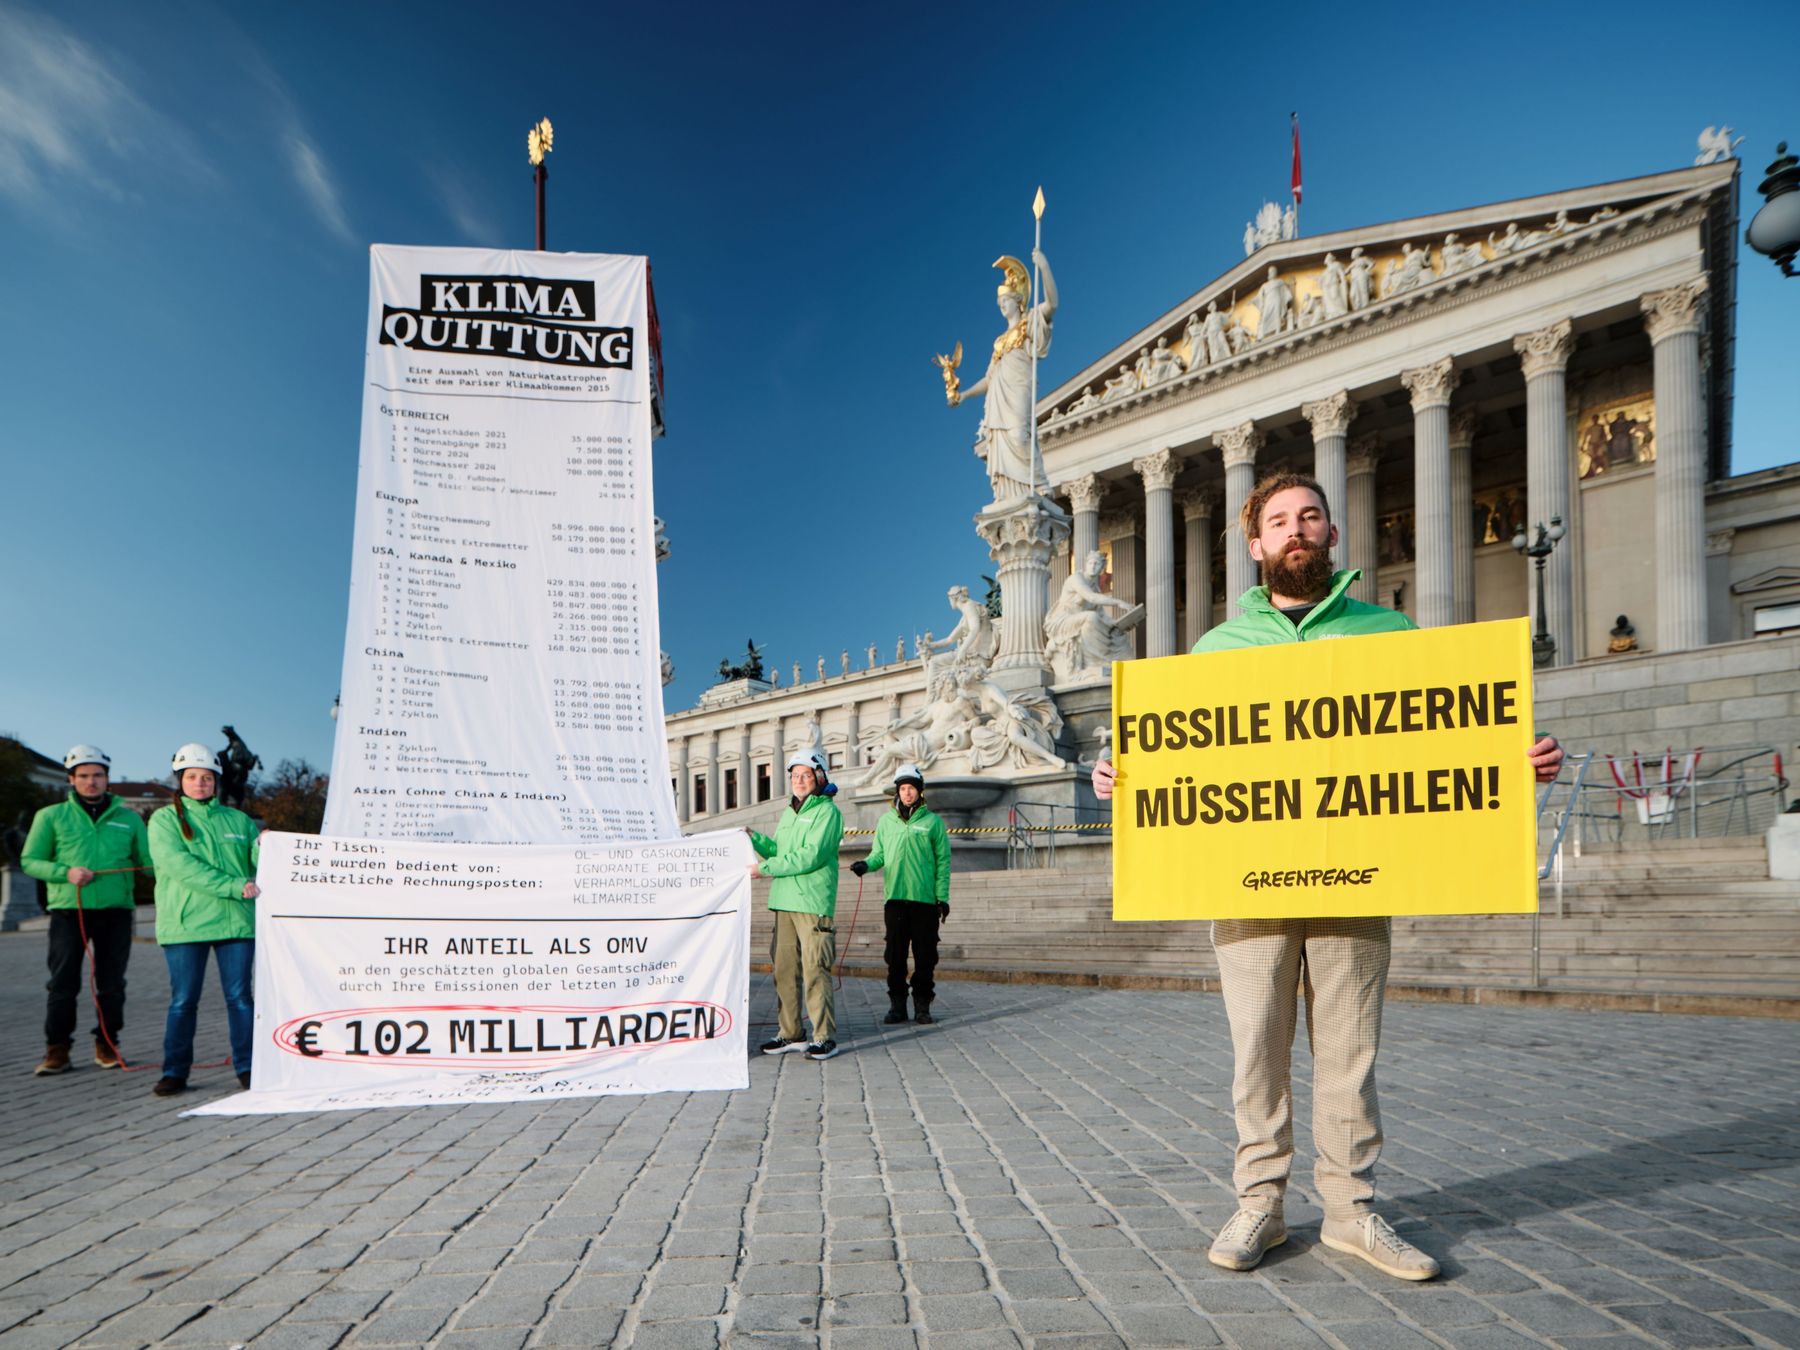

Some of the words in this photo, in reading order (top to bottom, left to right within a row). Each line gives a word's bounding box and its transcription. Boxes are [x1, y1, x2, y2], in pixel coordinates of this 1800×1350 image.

[432, 281, 585, 318] KLIMA
[384, 312, 630, 363] QUITTUNG
[409, 367, 432, 375] Eine
[439, 368, 479, 376] Auswahl
[509, 370, 606, 382] Naturkatastrophen
[436, 377, 453, 385] dem
[460, 379, 501, 387] Pariser
[507, 382, 582, 392] Klimaabkommen
[380, 403, 449, 421] ÖSTERREICH
[414, 426, 480, 436] Hagelschäden
[414, 437, 479, 448] Murenabgänge
[414, 447, 441, 456] Dürre
[413, 458, 469, 469] Hochwasser
[376, 491, 419, 506] Europa
[411, 511, 490, 527] Überschwemmung
[411, 523, 440, 532] Sturm
[410, 533, 456, 545] Weiteres
[462, 539, 529, 551] Extremwetter
[410, 552, 453, 564] Kanada
[475, 559, 516, 569] Mexiko
[409, 568, 456, 578] Hurrikan
[408, 578, 461, 590] Waldbrand
[408, 588, 437, 597] Dürre
[408, 599, 448, 610] Tornado
[407, 610, 436, 620] Hagel
[406, 621, 442, 631] Zyklon
[405, 631, 453, 643] Weiteres
[460, 638, 530, 650] Extremwetter
[365, 648, 404, 658] China
[403, 665, 488, 682] Überschwemmung
[404, 677, 440, 687] Taifun
[402, 688, 433, 697] Dürre
[402, 699, 433, 708] Sturm
[401, 710, 438, 719] Zyklon
[1120, 702, 1271, 755] FOSSILE
[1285, 680, 1518, 741] KONZERNE
[359, 727, 407, 737] Indien
[398, 744, 437, 753] Zyklon
[397, 754, 487, 767] Überschwemmung
[396, 766, 448, 775] Weiteres
[455, 769, 530, 778] Extremwetter
[354, 787, 396, 795] Asien
[406, 787, 446, 796] (ohne
[455, 790, 495, 799] China
[515, 792, 567, 802] Indien)
[1136, 776, 1302, 828] MÜSSEN
[1316, 765, 1501, 818] ZAHLEN!
[295, 839, 322, 850] Ihr
[333, 841, 385, 854] Tisch:
[609, 849, 633, 859] UND
[641, 847, 729, 858] GASKONZERNE
[293, 856, 320, 866] Sie
[330, 858, 386, 869] wurden
[396, 861, 458, 872] bedient
[469, 864, 501, 873] von:
[575, 864, 649, 874] IGNORANTE
[658, 862, 715, 872] POLITIK
[290, 872, 393, 885] Zusätzliche
[404, 876, 543, 890] Rechnungsposten:
[690, 878, 714, 888] DER
[1242, 867, 1379, 891] GREENPEACE
[573, 893, 657, 904] KLIMAKRISE
[384, 937, 428, 954] IHR
[445, 938, 532, 954] ANTEIL
[550, 938, 591, 954] ALS
[607, 937, 648, 953] OMV
[338, 966, 355, 975] an
[365, 964, 391, 975] den
[400, 965, 493, 978] geschätzten
[503, 964, 568, 977] globalen
[577, 960, 677, 974] Gesamtschäden
[339, 982, 381, 991] durch
[392, 982, 425, 991] Ihre
[435, 981, 518, 991] Emissionen
[528, 981, 551, 990] der
[561, 980, 616, 990] letzten
[626, 978, 639, 988] 10
[648, 975, 684, 986] Jahre
[295, 1021, 323, 1056] €
[345, 1020, 431, 1056] 102
[450, 1006, 716, 1054] MILLIARDEN
